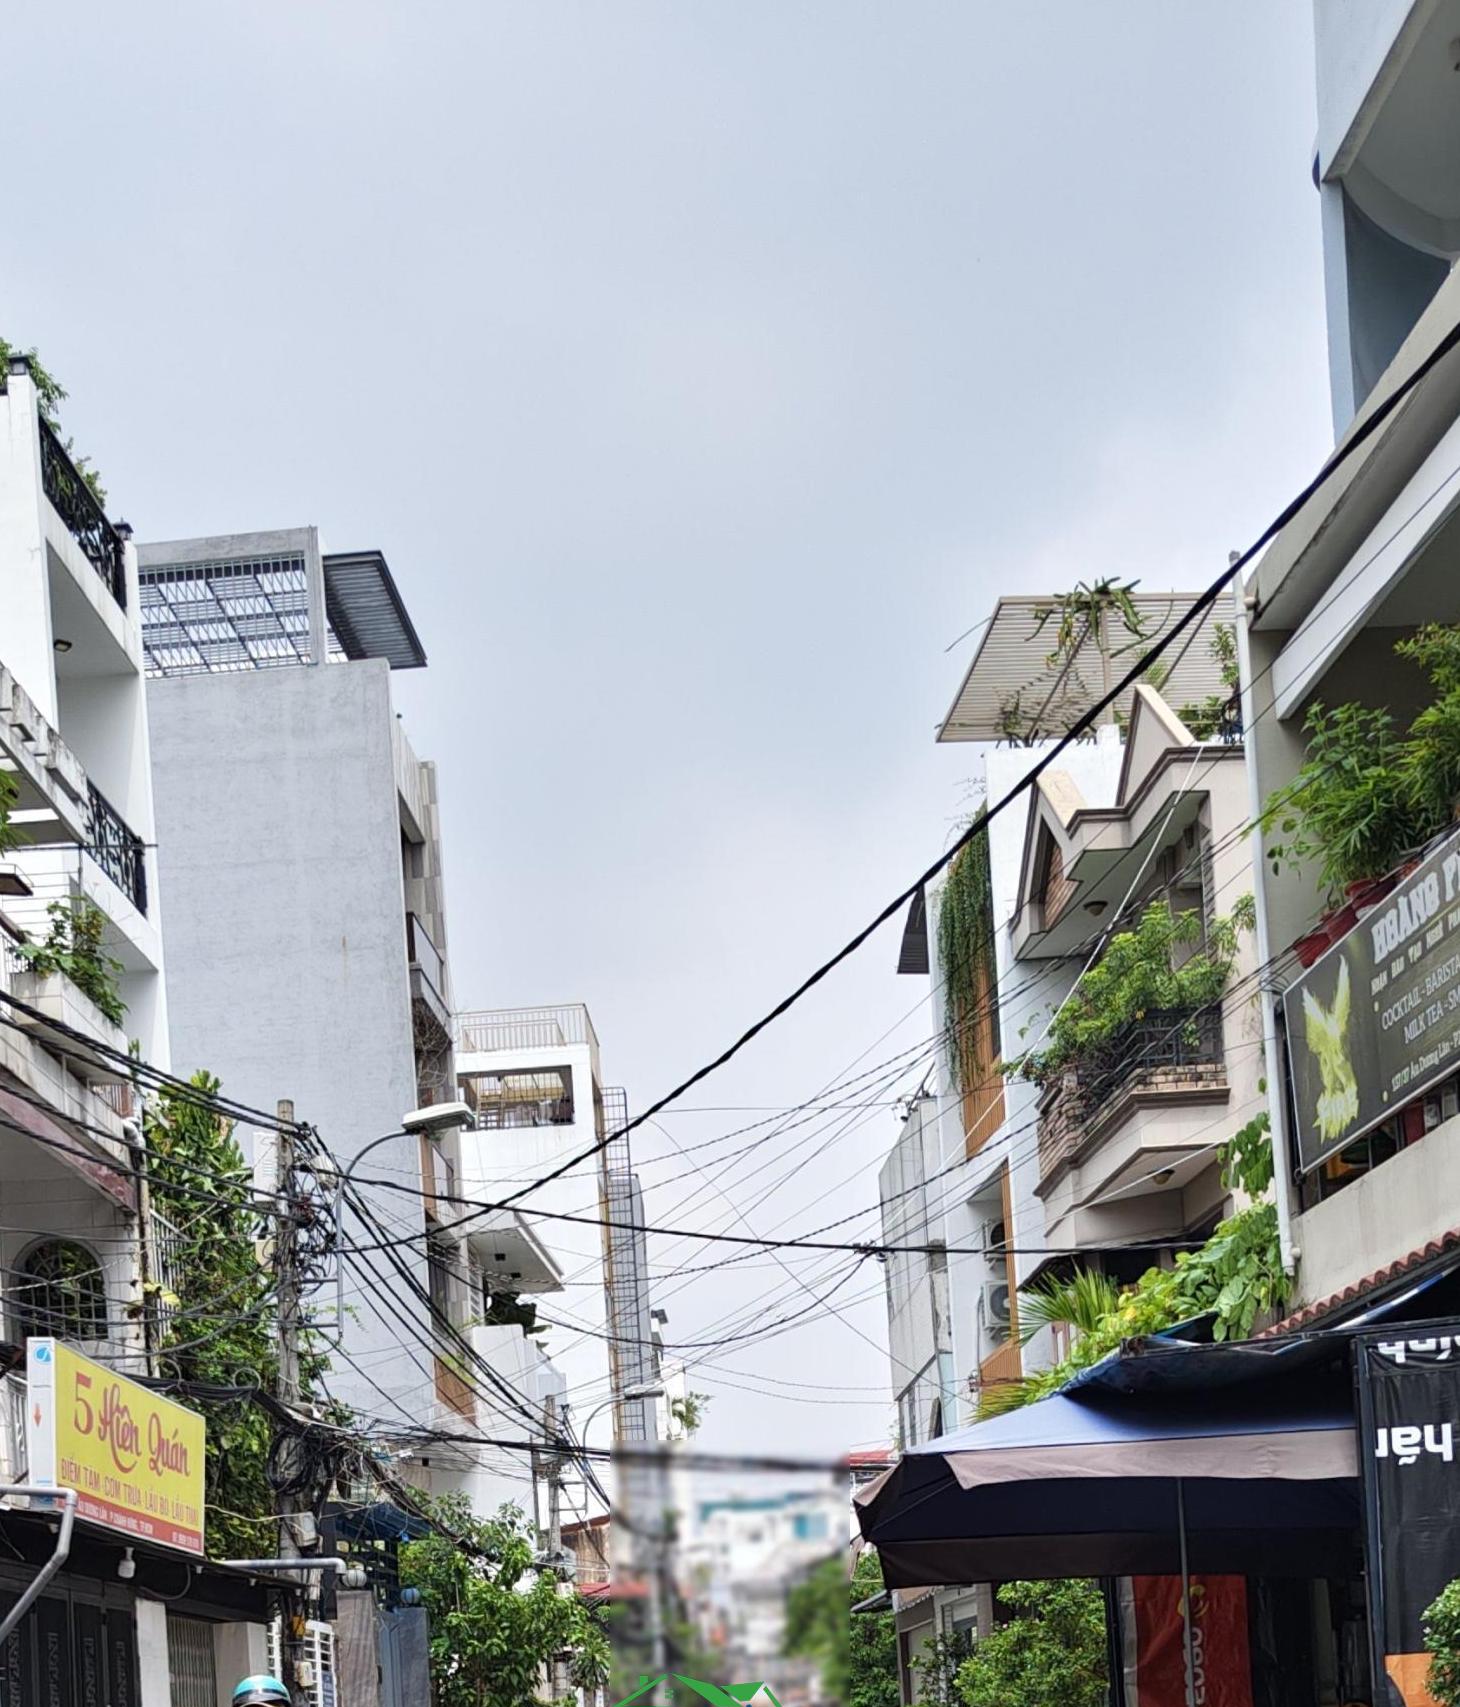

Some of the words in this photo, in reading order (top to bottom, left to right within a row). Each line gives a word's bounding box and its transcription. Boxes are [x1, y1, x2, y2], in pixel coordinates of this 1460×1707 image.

[1442, 848, 1460, 902] P
[1382, 986, 1422, 1030] COCKTAIL
[1404, 1012, 1426, 1044] MILK
[1426, 1000, 1444, 1027] TEA
[74, 1371, 94, 1435] 5
[148, 1412, 190, 1477] Quán
